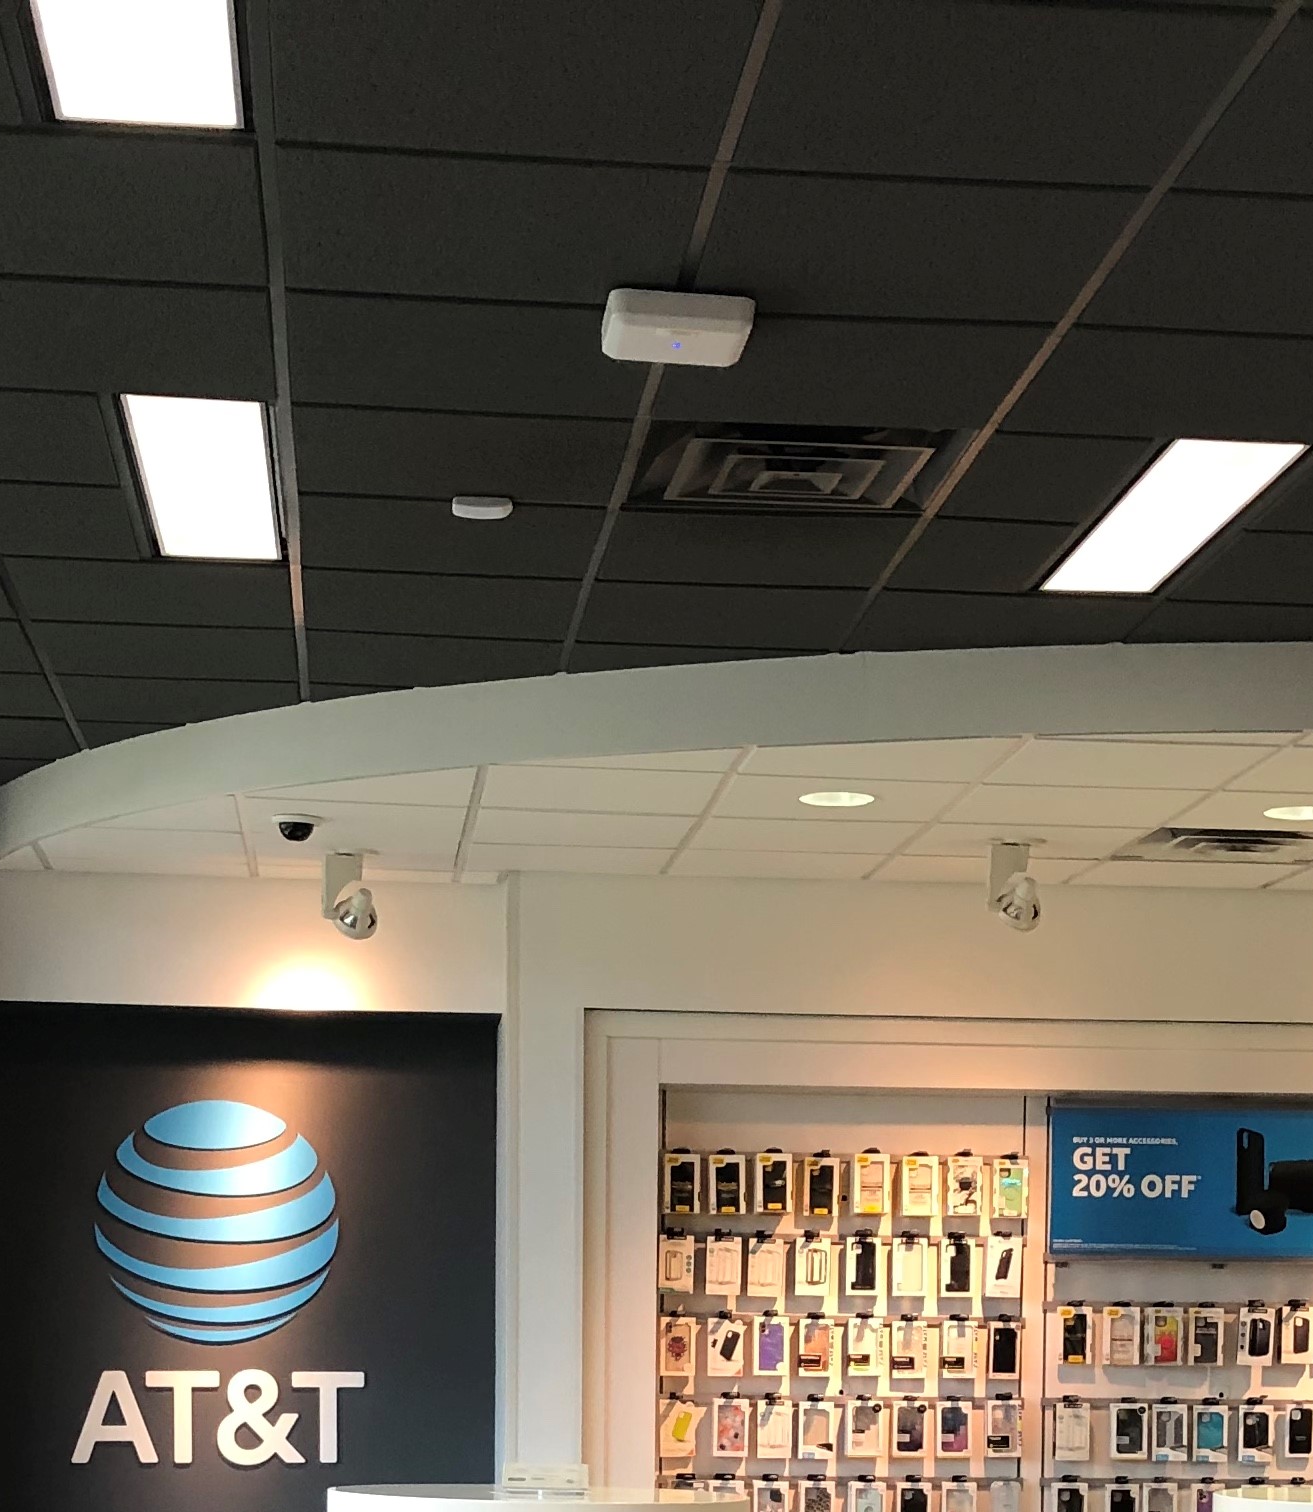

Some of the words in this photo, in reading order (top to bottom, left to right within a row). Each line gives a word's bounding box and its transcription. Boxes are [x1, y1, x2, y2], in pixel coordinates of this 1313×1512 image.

[1072, 1146, 1131, 1171] GET
[1072, 1173, 1136, 1198] 20%
[70, 1368, 366, 1467] AT&T
